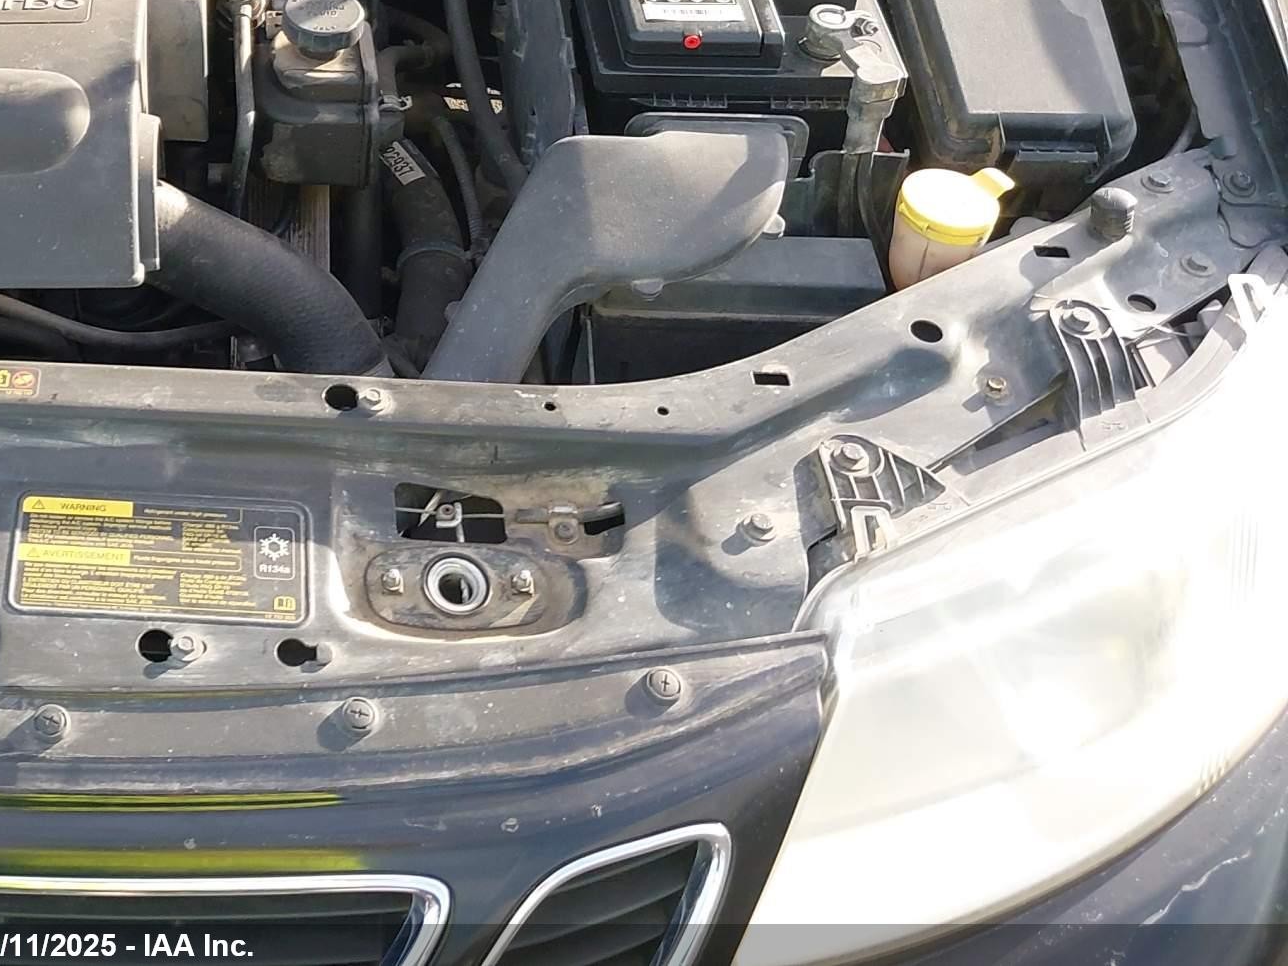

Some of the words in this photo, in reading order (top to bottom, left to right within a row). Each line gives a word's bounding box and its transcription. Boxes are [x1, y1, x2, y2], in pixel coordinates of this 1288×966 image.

[60, 502, 107, 512] WARNING
[41, 549, 125, 561] AVERTISSEMENT
[258, 563, 291, 574] R134a
